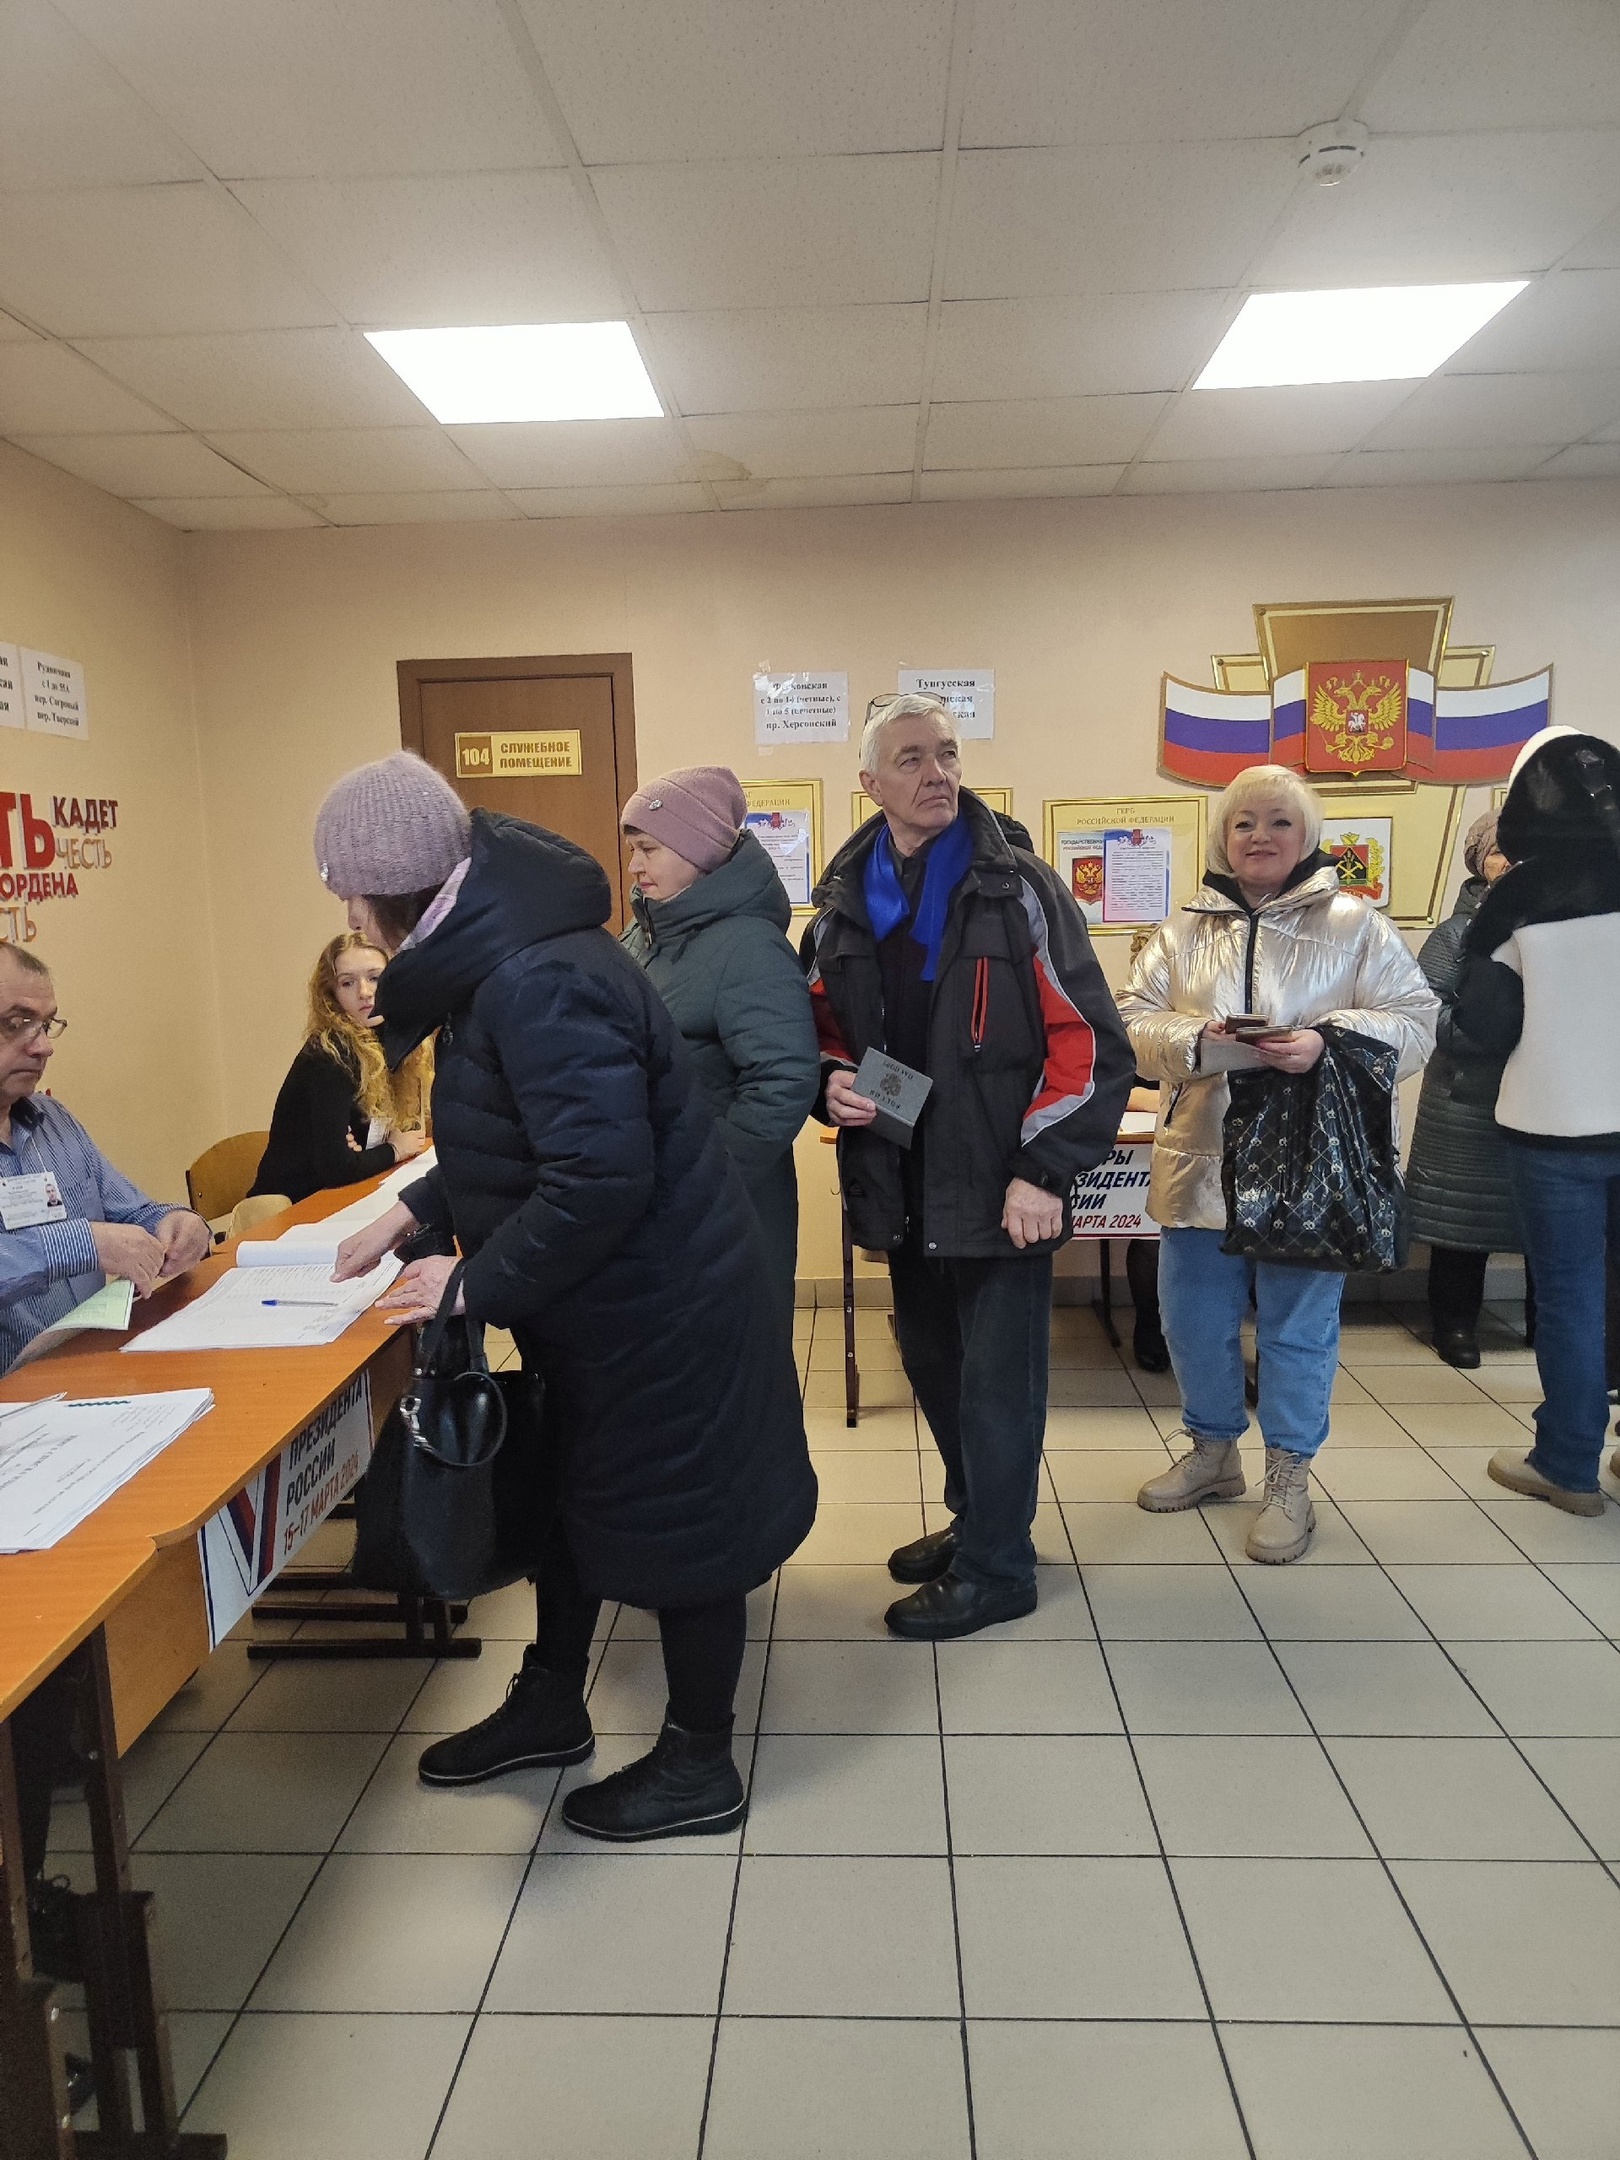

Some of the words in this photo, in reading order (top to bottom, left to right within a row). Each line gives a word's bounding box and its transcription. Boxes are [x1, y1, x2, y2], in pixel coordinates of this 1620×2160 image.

[916, 678, 975, 690] Тунгусская
[766, 722, 780, 731] пр.
[783, 718, 837, 730] Херсонский
[500, 741, 570, 753] СЛУЖЕБНОЕ
[462, 748, 490, 766] 104
[500, 756, 572, 769] ПОМЕЩЕНИЕ
[53, 796, 119, 834] КАДЕТ
[1076, 816, 1126, 825] РОССИЙСКОЙ
[1129, 815, 1175, 824] ФЕДЕРАЦИИ
[56, 838, 113, 869] ЧЕСТЬ
[0, 871, 79, 902] ОРДЕНА
[1109, 1214, 1141, 1228] 2024
[289, 1377, 363, 1471] ПРЕЗИДЕНТА
[285, 1438, 336, 1516] РОССИИ
[310, 1471, 341, 1526] МАРТА
[340, 1452, 359, 1492] 2024
